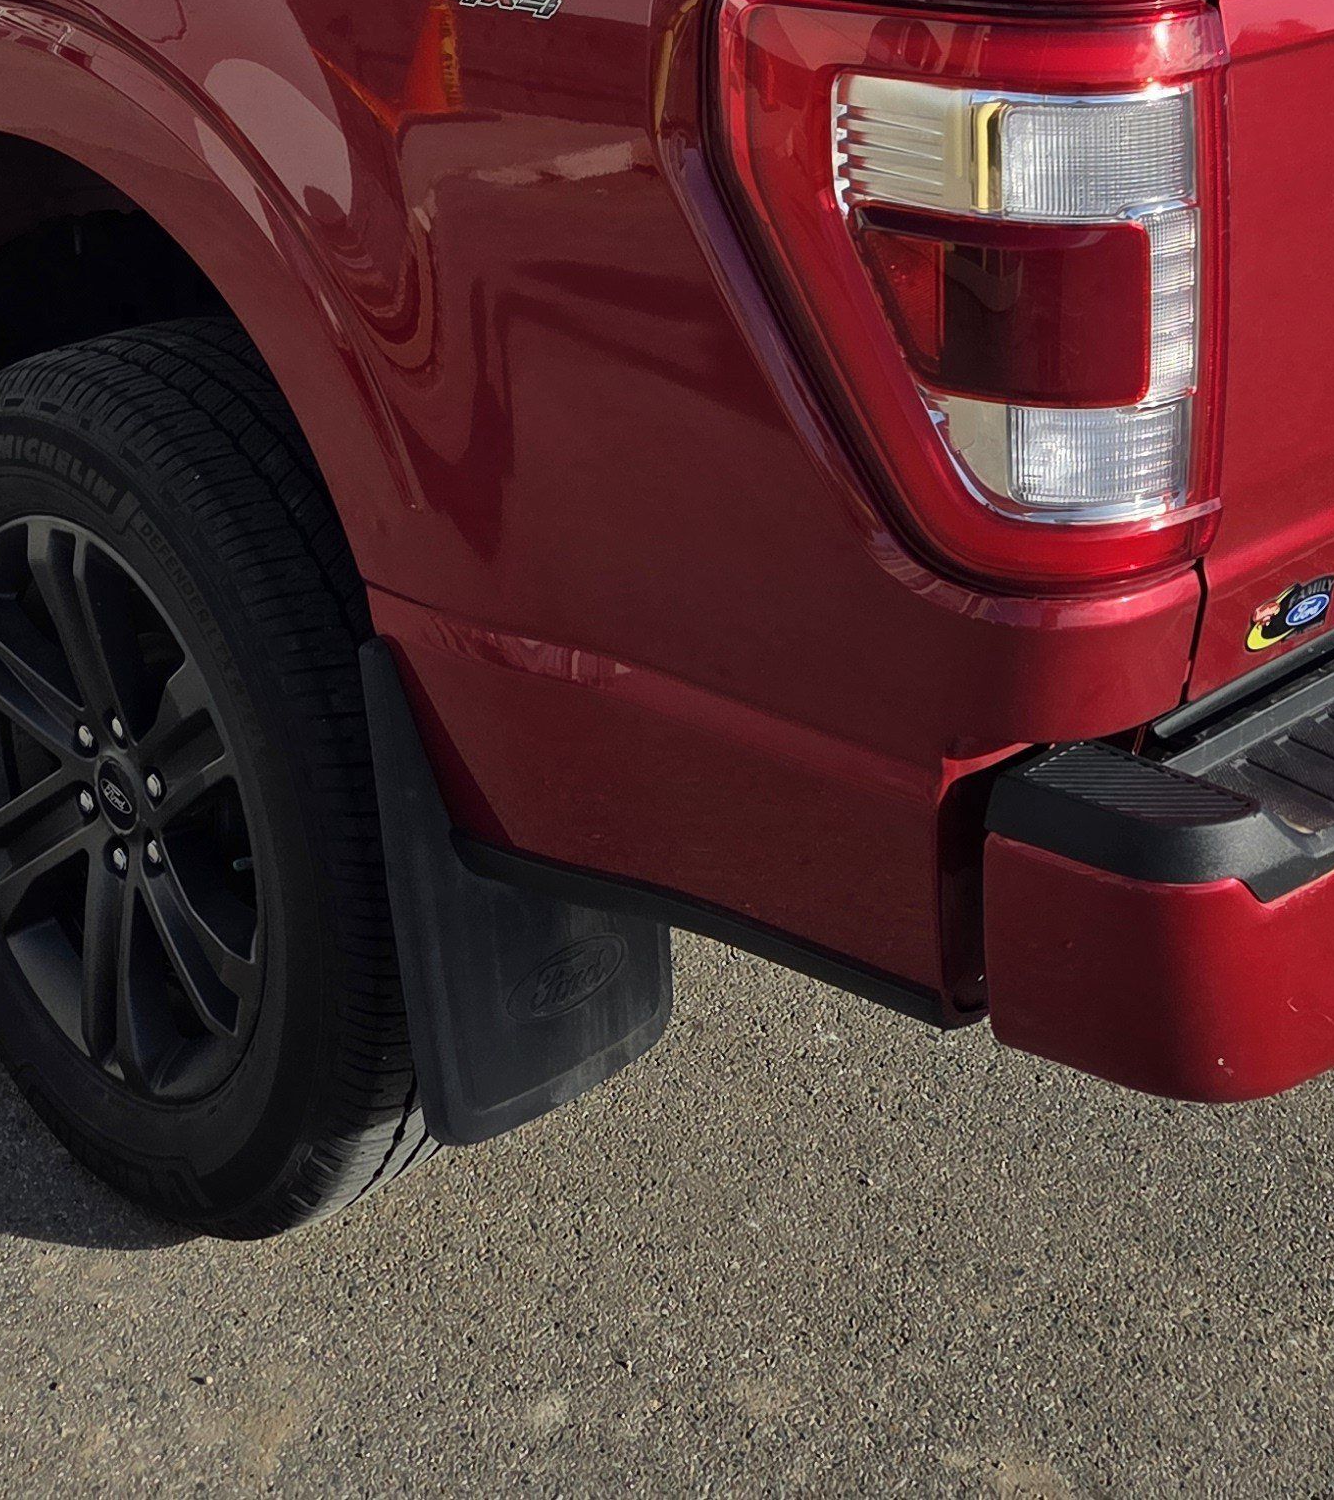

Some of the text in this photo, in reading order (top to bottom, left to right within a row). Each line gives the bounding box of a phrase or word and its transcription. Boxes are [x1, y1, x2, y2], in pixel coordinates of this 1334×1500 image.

[139, 521, 212, 625] DEFENDER
[1292, 598, 1322, 622] Ford
[103, 784, 127, 811] Ford
[529, 948, 606, 1014] Ford
